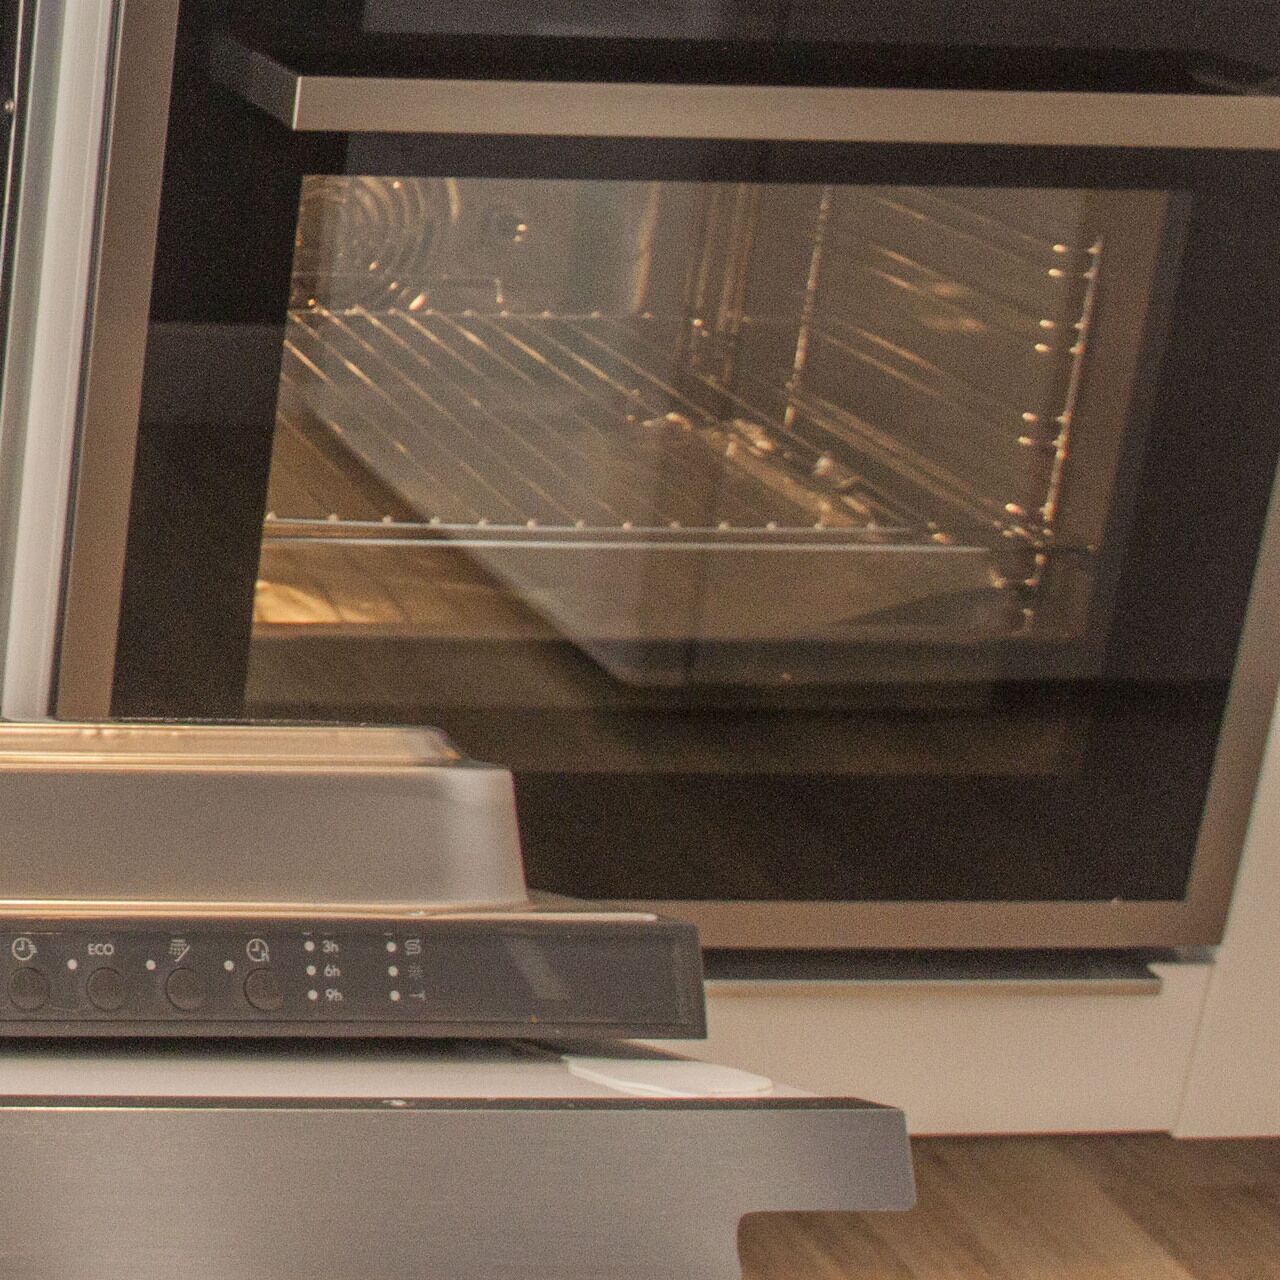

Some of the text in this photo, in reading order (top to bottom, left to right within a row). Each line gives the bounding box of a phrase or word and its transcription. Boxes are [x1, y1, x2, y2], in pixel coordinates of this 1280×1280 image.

[87, 943, 114, 956] ECO
[322, 940, 339, 953] 3h
[324, 965, 341, 978] 6h
[325, 988, 343, 1002] 9h
